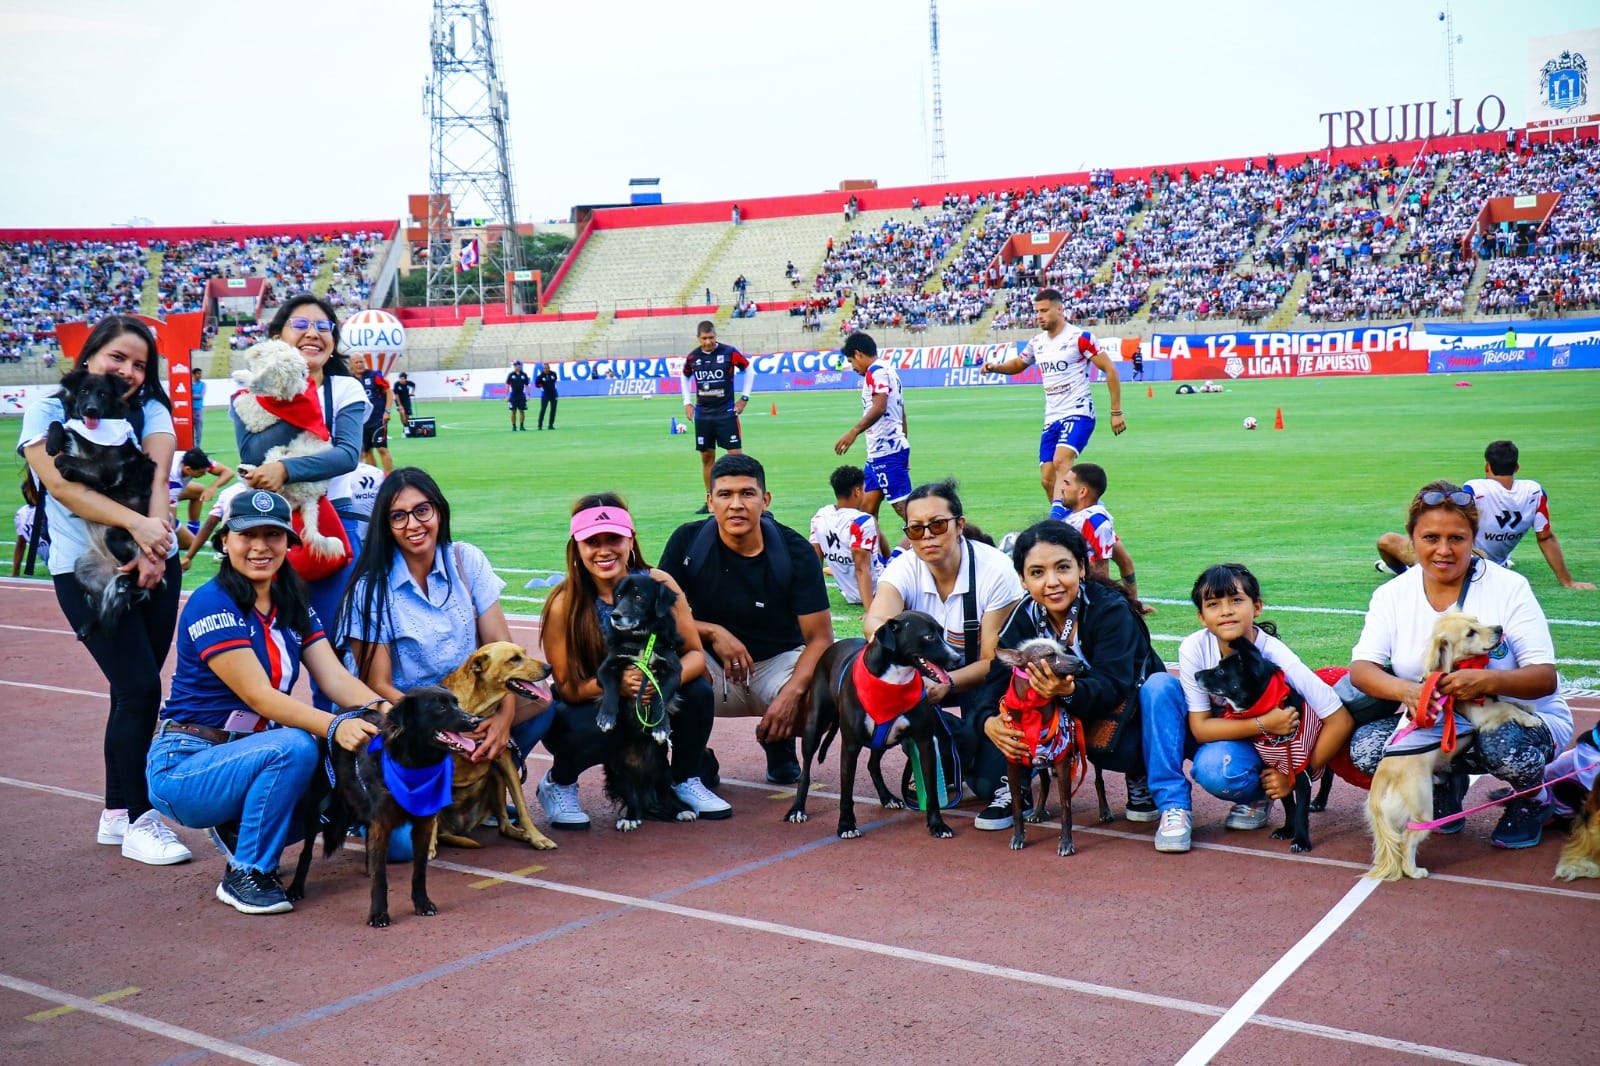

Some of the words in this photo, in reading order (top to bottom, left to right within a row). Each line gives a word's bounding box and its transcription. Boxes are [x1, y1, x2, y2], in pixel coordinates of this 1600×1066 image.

[1319, 95, 1506, 149] TRUJILLO
[350, 328, 402, 347] UPAO
[1153, 335, 1191, 359] LA
[1204, 334, 1238, 358] 12
[1250, 326, 1408, 356] TRICOLOR
[559, 356, 670, 381] LOCURA
[1300, 356, 1313, 373] TE
[1314, 354, 1370, 372] APUESTO
[695, 369, 724, 381] UPAO
[1061, 421, 1075, 434] 31
[188, 608, 238, 642] PROMOCIÓN
